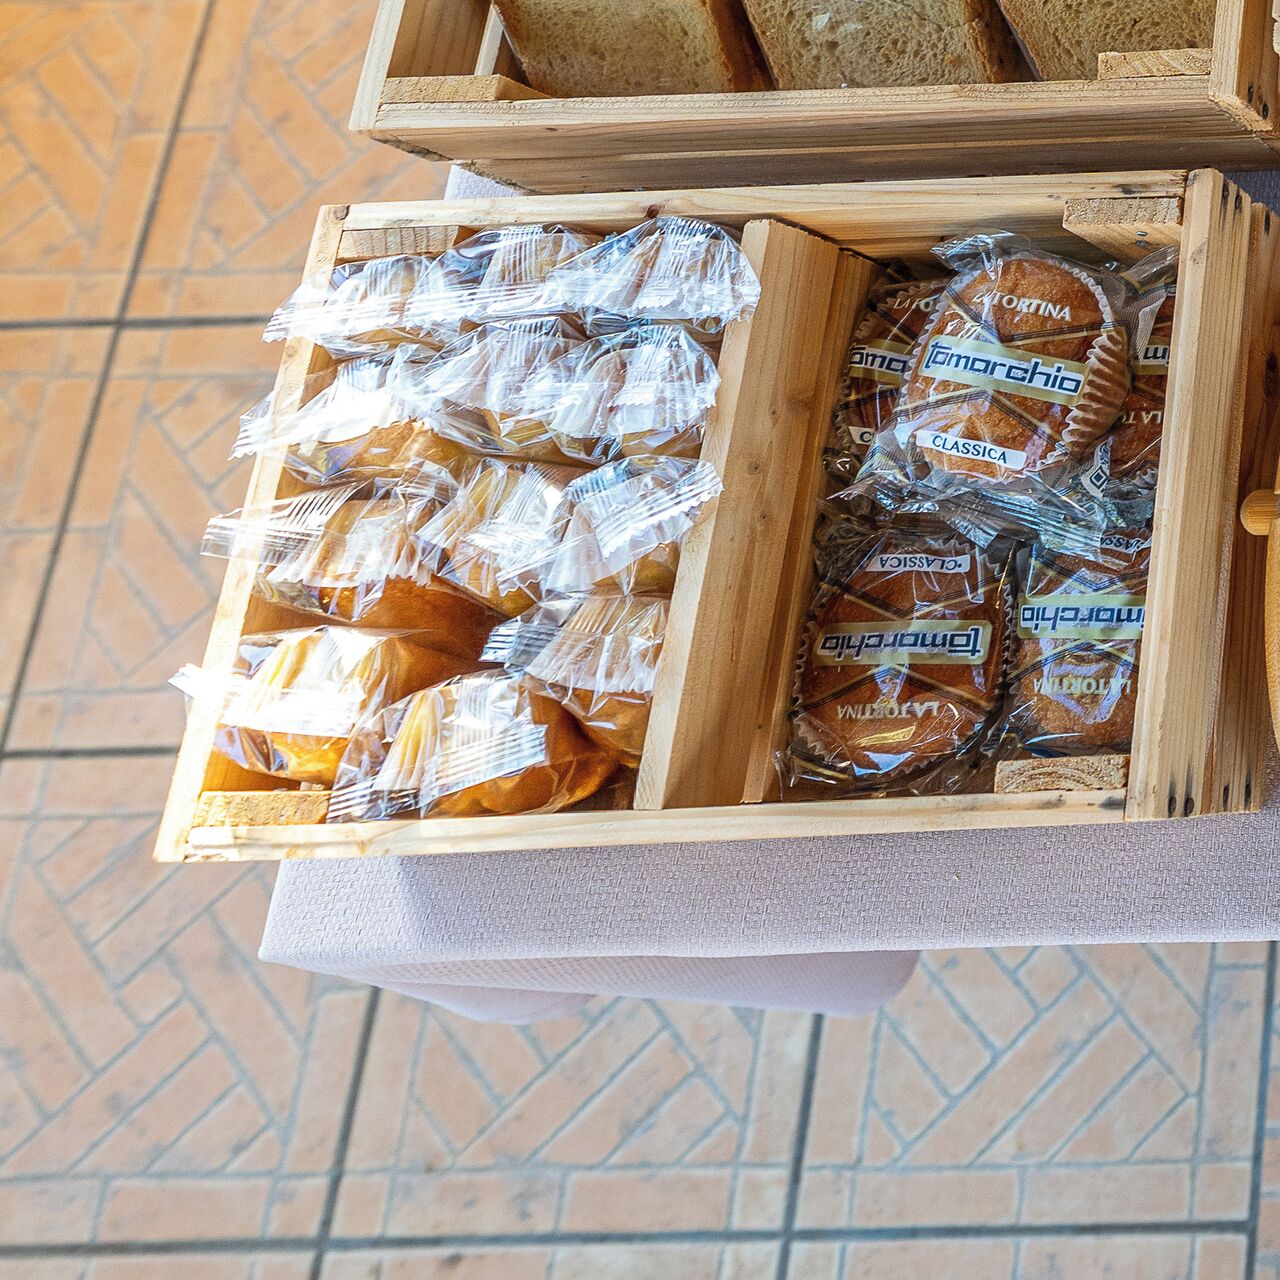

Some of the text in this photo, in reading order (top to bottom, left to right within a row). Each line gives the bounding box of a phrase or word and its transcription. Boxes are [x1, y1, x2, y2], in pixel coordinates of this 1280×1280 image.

[992, 292, 1072, 321] TORTINA
[932, 435, 1007, 464] CLASSICA
[879, 556, 958, 571] CLASSICA
[1033, 677, 1107, 695] TORTINA
[837, 701, 940, 719] LA TORTINA
